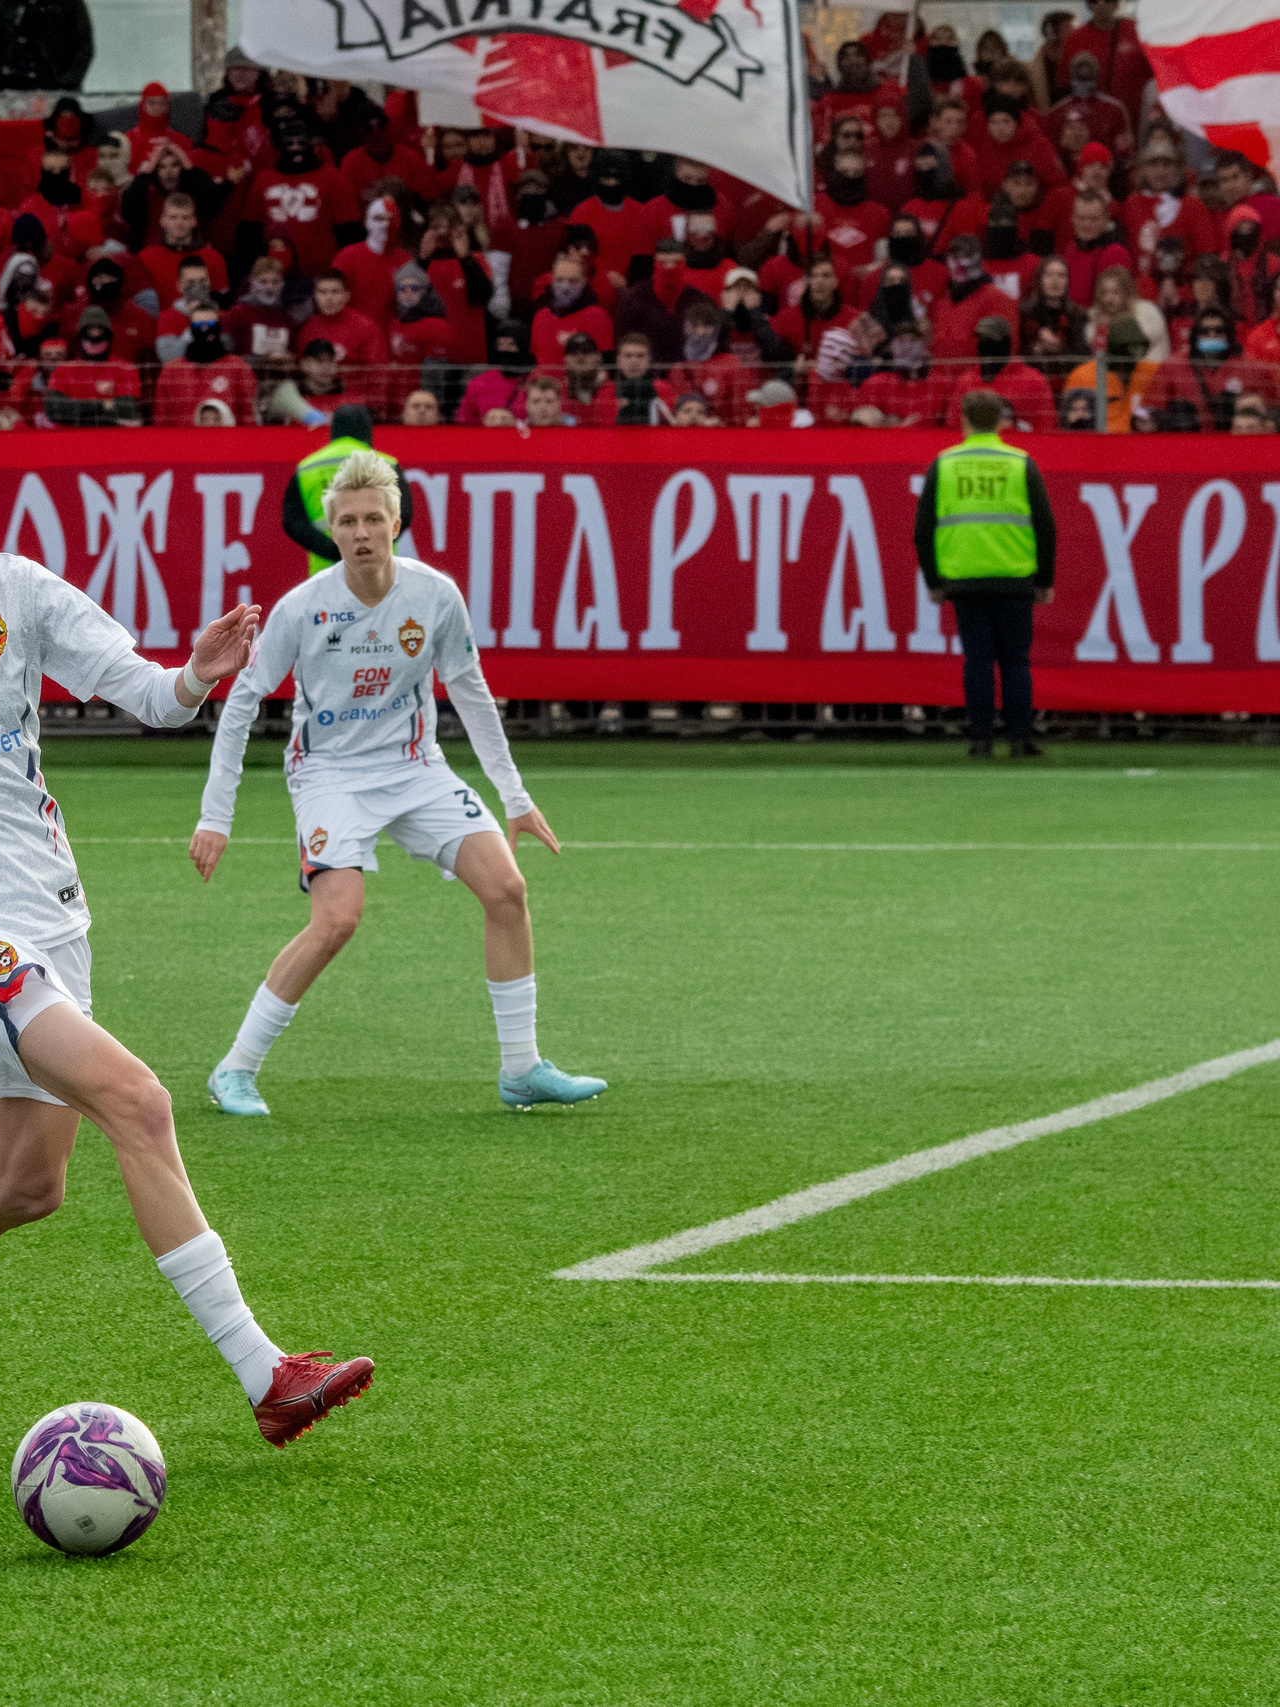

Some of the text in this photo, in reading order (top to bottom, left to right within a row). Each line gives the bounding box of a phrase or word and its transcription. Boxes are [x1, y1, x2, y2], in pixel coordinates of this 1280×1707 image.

[330, 611, 356, 623] ПСБ
[352, 667, 391, 684] FON
[352, 683, 391, 699] BET
[338, 694, 410, 723] самет
